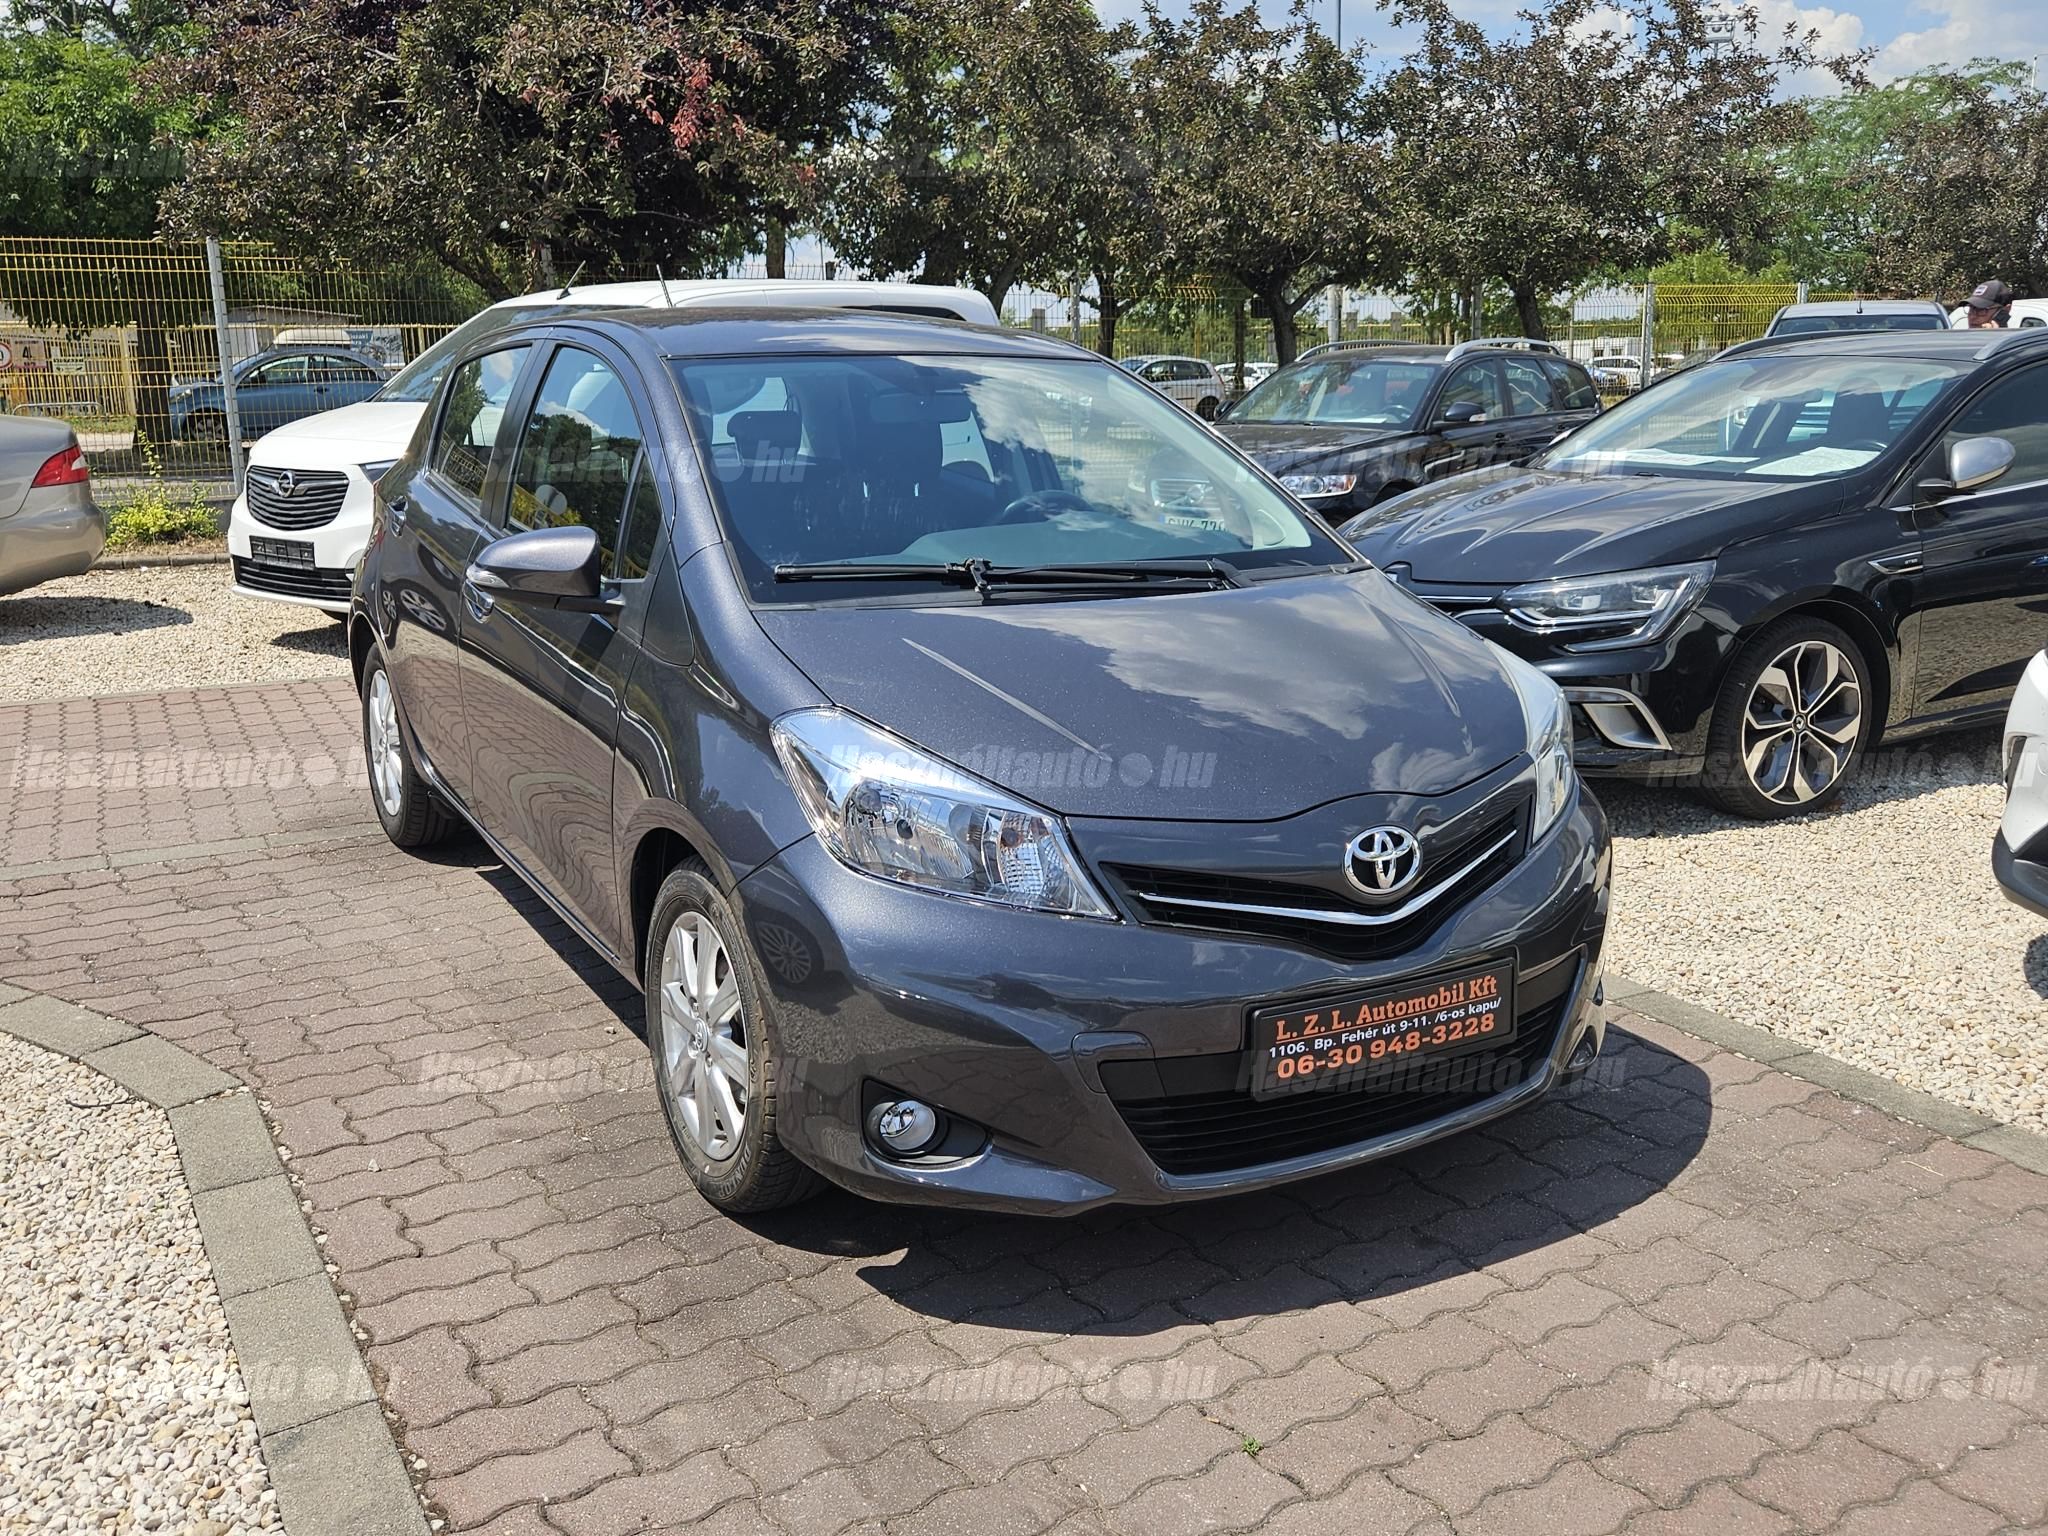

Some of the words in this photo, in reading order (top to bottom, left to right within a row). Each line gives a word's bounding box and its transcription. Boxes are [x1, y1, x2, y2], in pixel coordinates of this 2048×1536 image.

[1269, 1041, 1310, 1058] 1106.
[1314, 1037, 1337, 1051] Bp.
[1341, 1026, 1379, 1044] Fehér
[1382, 1022, 1397, 1036] út
[1399, 1015, 1432, 1032] 9-11.
[1434, 1008, 1466, 1024] /6-os
[1468, 996, 1502, 1015] kapu/
[1276, 1020, 1299, 1041] L.
[1303, 1014, 1326, 1036] Z.
[1331, 1010, 1352, 1031] L.
[1356, 981, 1465, 1026] Automobil
[1469, 975, 1498, 999] Kft
[1277, 1044, 1363, 1079] 06-30
[1370, 1013, 1495, 1059] 948-3228
